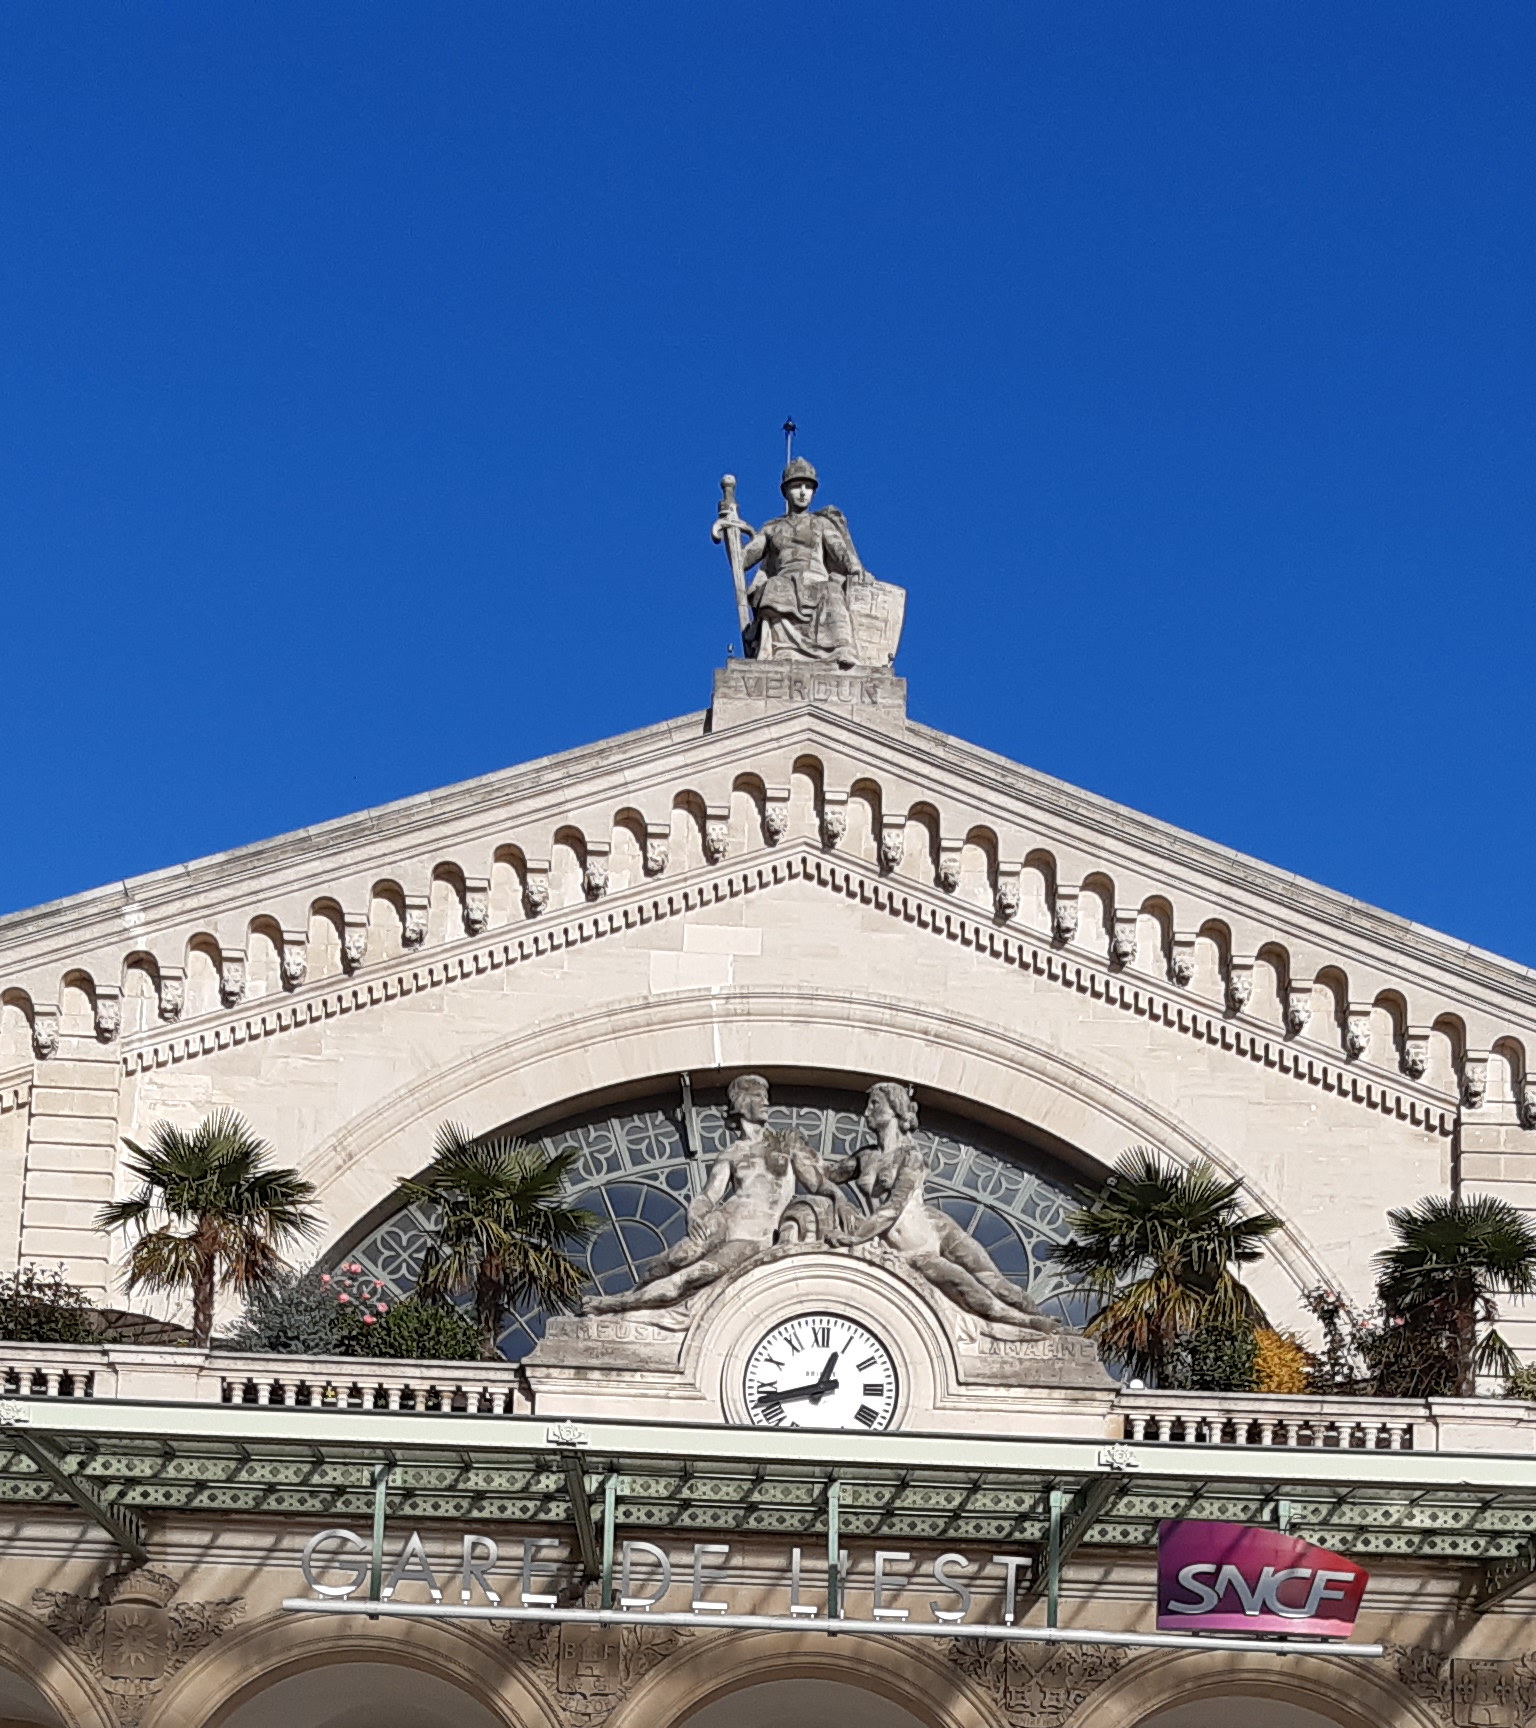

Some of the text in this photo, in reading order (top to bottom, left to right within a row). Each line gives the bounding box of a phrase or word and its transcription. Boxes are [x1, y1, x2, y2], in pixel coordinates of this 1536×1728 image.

[741, 674, 879, 705] VERDUN
[576, 1322, 668, 1342] MEUSE
[811, 1327, 831, 1348] XII
[978, 1341, 1095, 1360] LA MARNE
[855, 1355, 878, 1372] II
[862, 1383, 884, 1397] III
[302, 1528, 1033, 1621] GARE DE L'EST
[1167, 1563, 1356, 1619] SNCF
